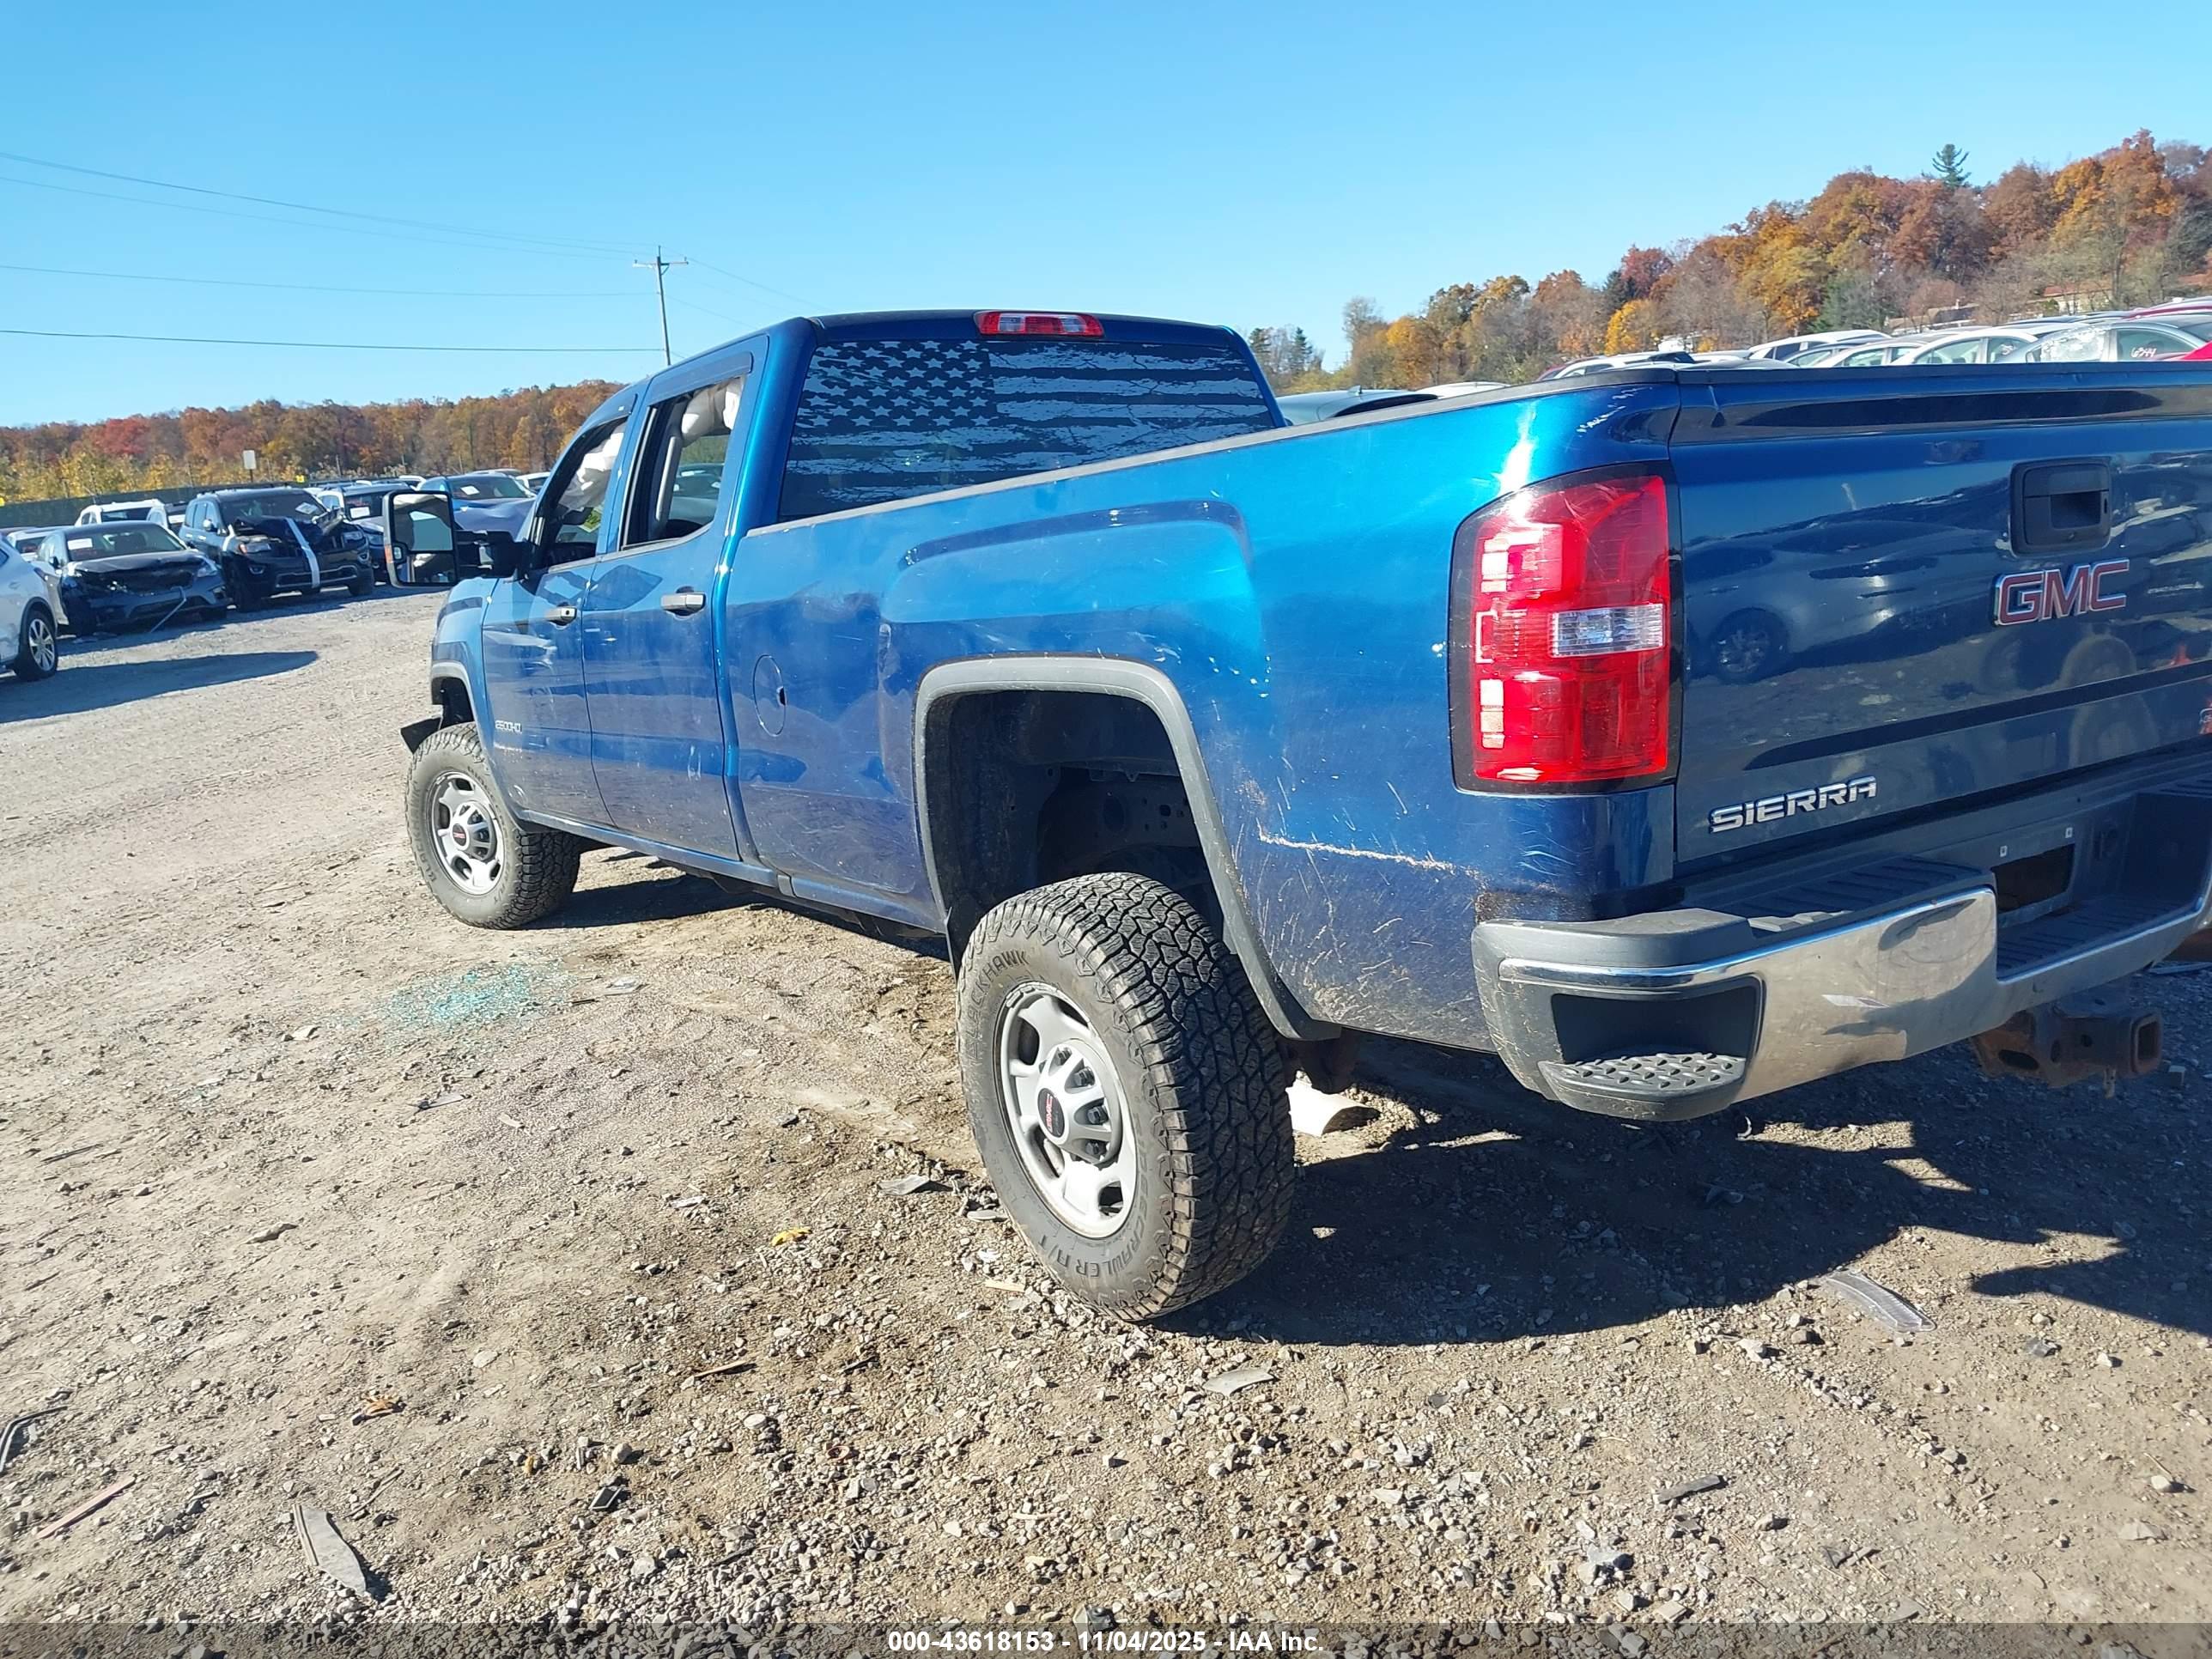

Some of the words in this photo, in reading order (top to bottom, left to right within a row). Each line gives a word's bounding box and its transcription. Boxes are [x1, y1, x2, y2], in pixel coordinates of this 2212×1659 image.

[1994, 559, 2130, 626] GMC
[1710, 775, 1877, 833] SIERRA
[965, 949, 1030, 1060] BLACKHAWK
